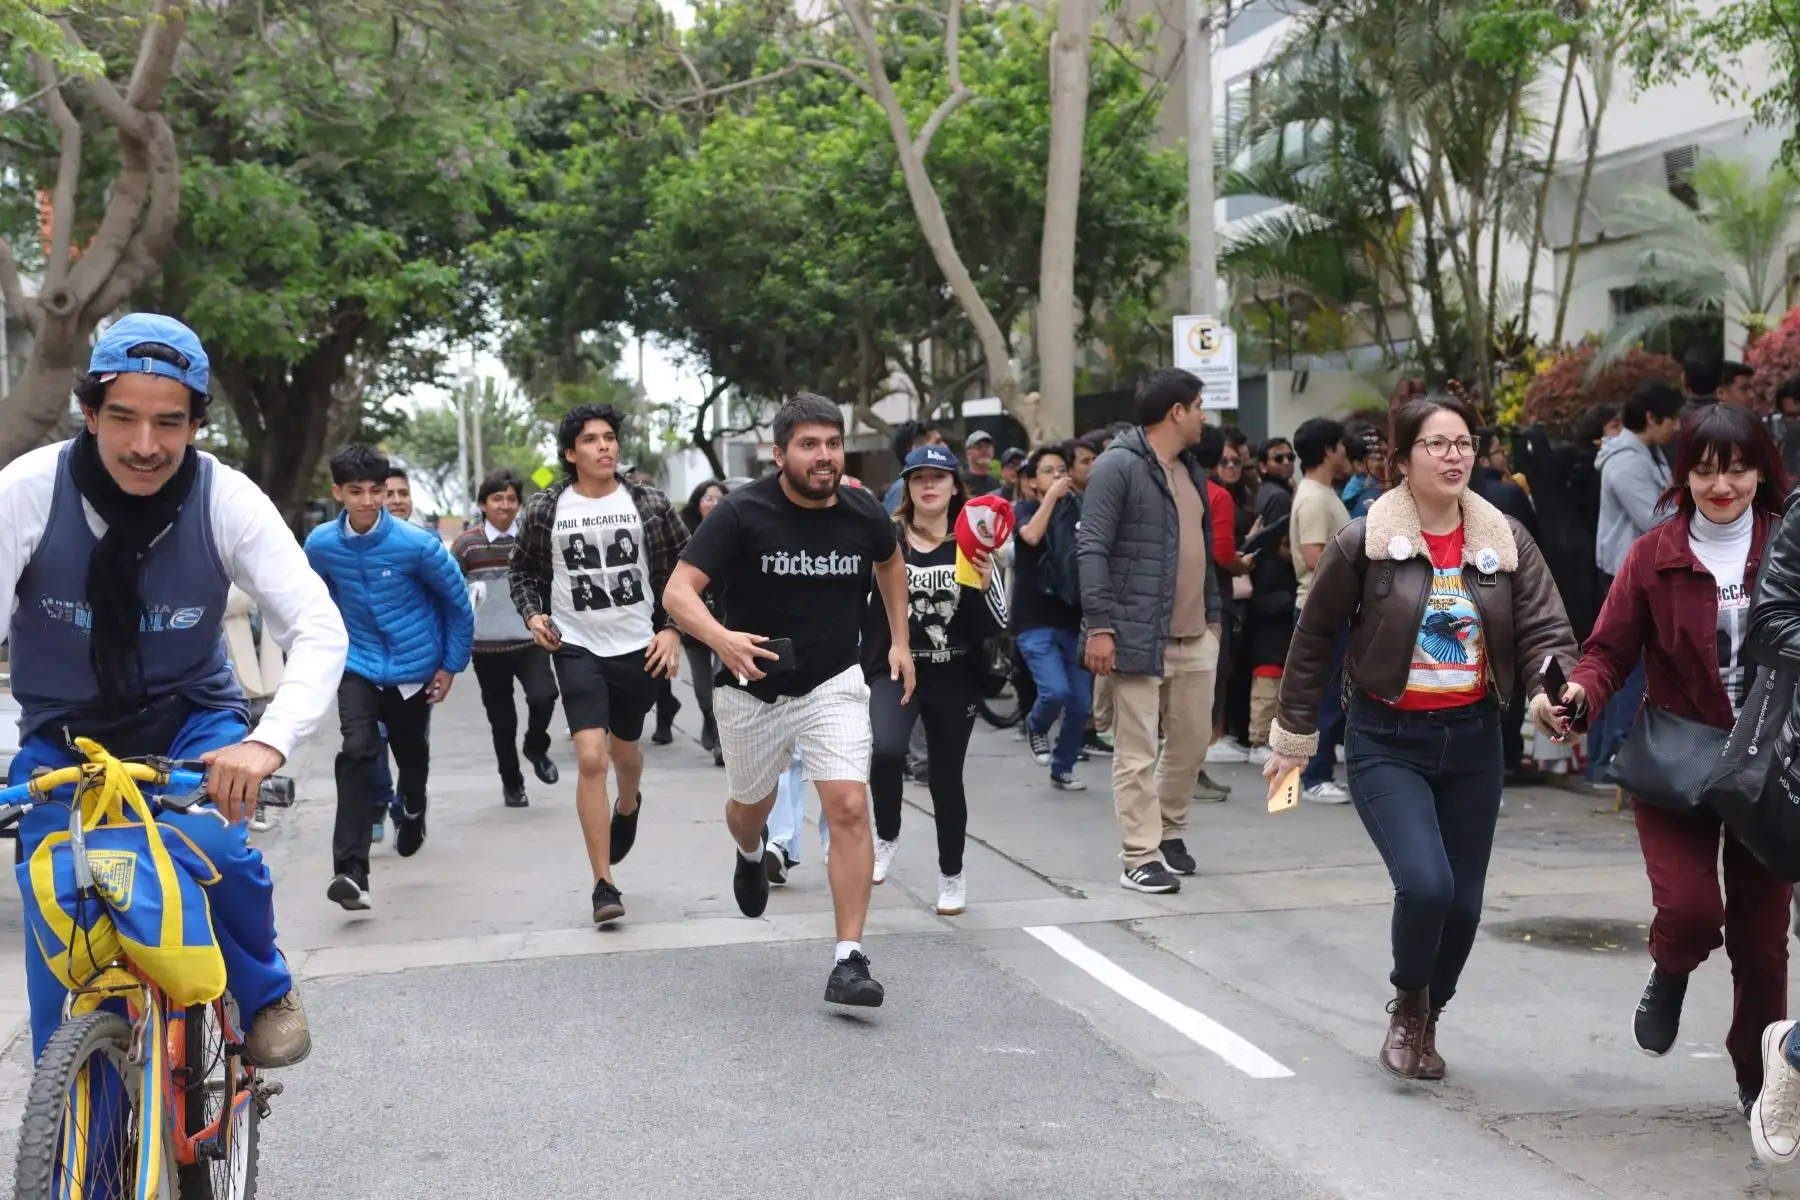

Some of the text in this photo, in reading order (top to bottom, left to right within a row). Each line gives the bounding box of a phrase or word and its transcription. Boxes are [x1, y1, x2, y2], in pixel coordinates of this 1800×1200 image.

[557, 514, 637, 530] PAUL McCARTNEY
[761, 550, 862, 576] röckstar
